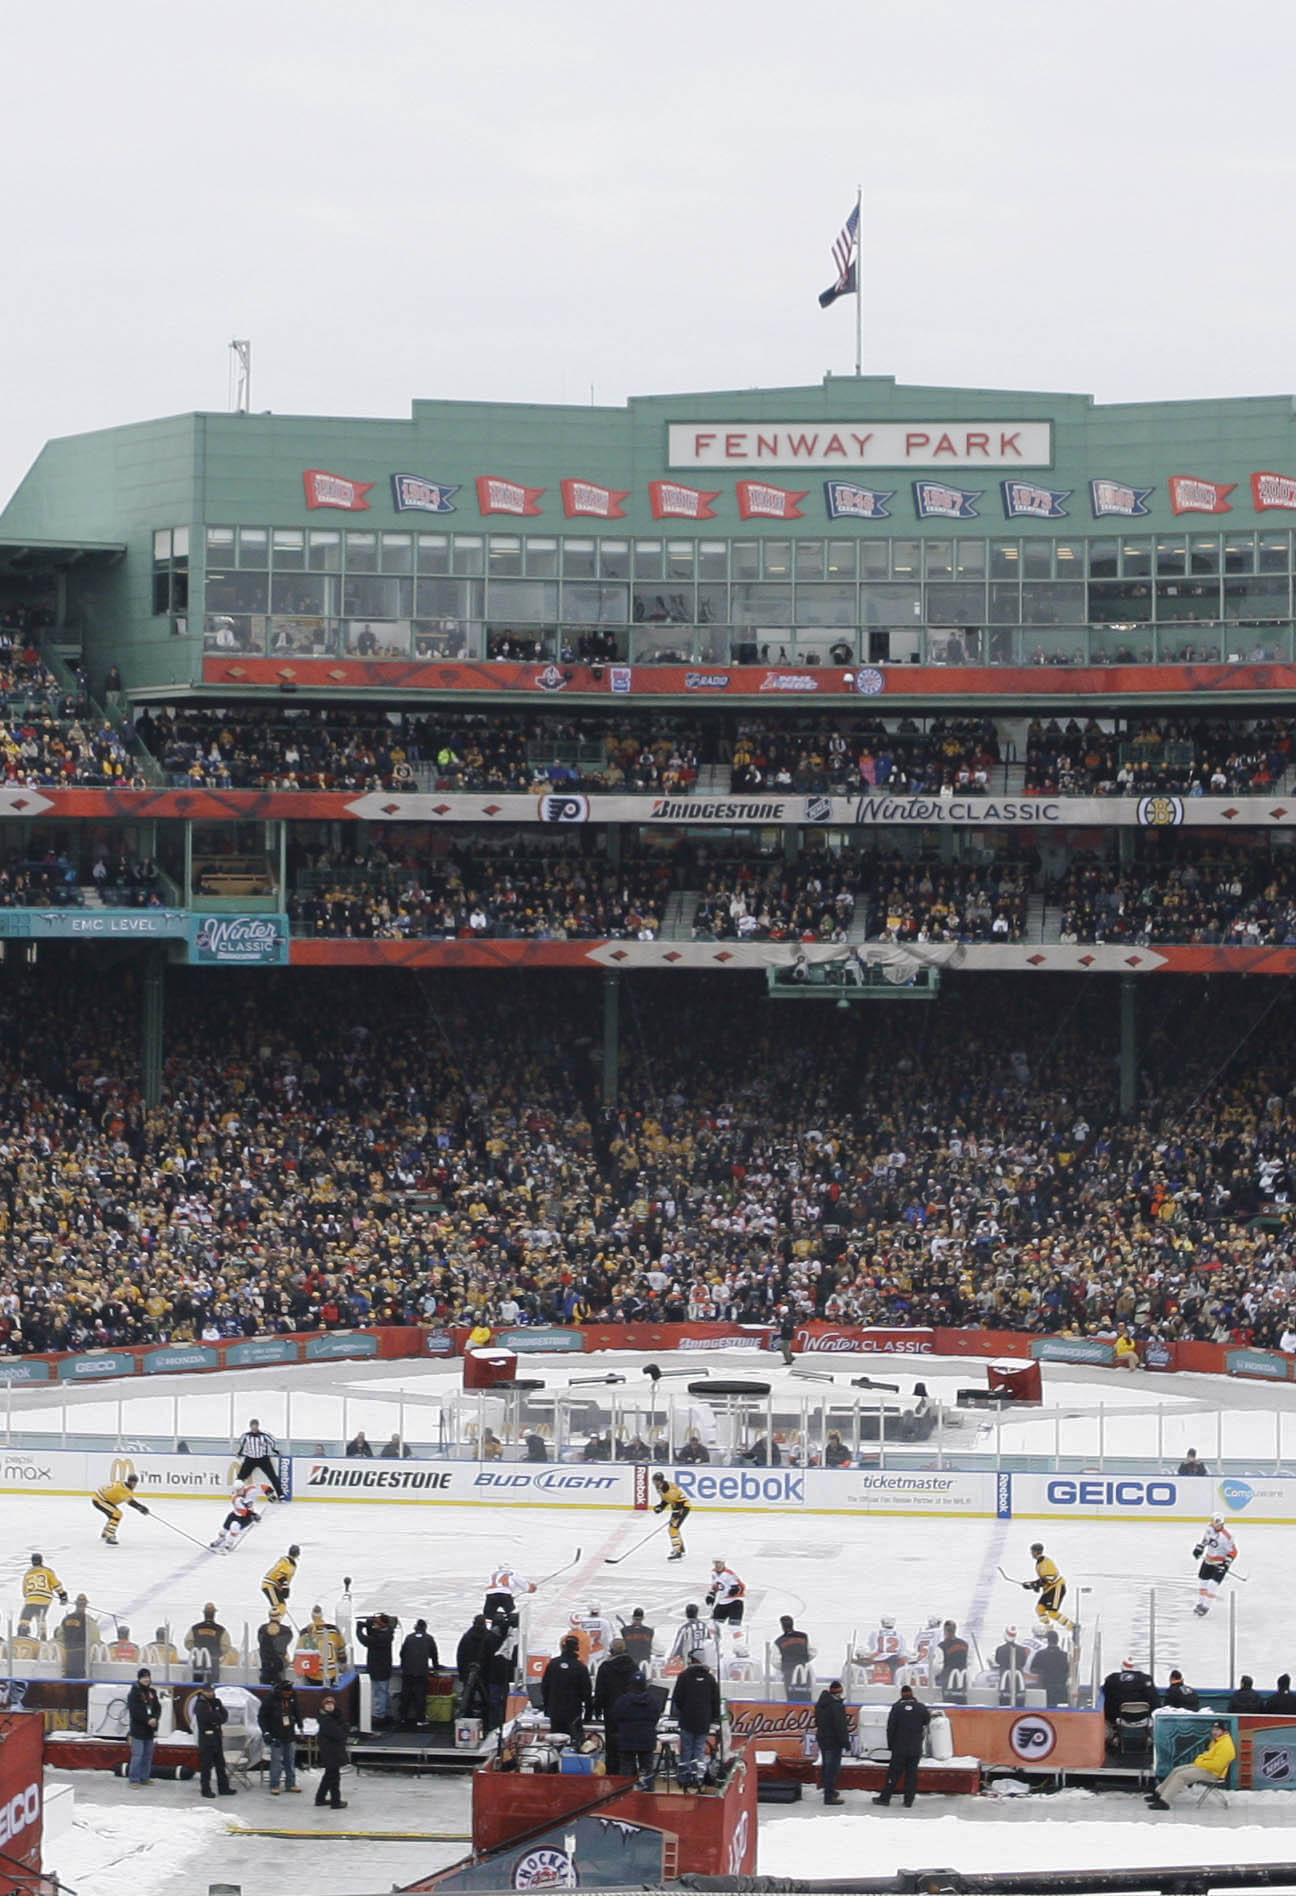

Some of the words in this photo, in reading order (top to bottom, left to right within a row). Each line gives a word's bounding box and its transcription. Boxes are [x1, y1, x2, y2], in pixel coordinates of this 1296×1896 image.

[695, 433, 873, 458] FENWAY
[905, 432, 1023, 457] PARK
[649, 799, 786, 819] BRIDGESTONE
[847, 797, 944, 822] Winter
[949, 803, 1060, 820] CLASSIC
[72, 919, 104, 931] EMC
[111, 919, 157, 931] LEVEL
[204, 917, 277, 952] Winter
[218, 942, 273, 952] CLASSIC
[679, 1338, 762, 1350] BRIDGESTONE
[797, 1331, 861, 1352] Winter
[860, 1340, 933, 1354] CLASSIC
[75, 1359, 116, 1374] GEICO
[5, 1465, 52, 1481] max
[140, 1472, 162, 1484] i'm
[166, 1471, 206, 1486] lovin'
[208, 1473, 221, 1486] it
[306, 1465, 453, 1489] BRIDGESTONE
[473, 1472, 532, 1487] BUD
[542, 1475, 620, 1490] LIGHT
[636, 1466, 646, 1505] Reebok
[674, 1470, 805, 1500] Reebok
[863, 1475, 953, 1490] ticketmaster
[999, 1473, 1009, 1513] Reebok
[1047, 1481, 1177, 1506] GEICO
[1224, 1486, 1284, 1499] Compuware
[877, 1636, 899, 1654] 12
[301, 1660, 310, 1669] G
[532, 1661, 544, 1672] G
